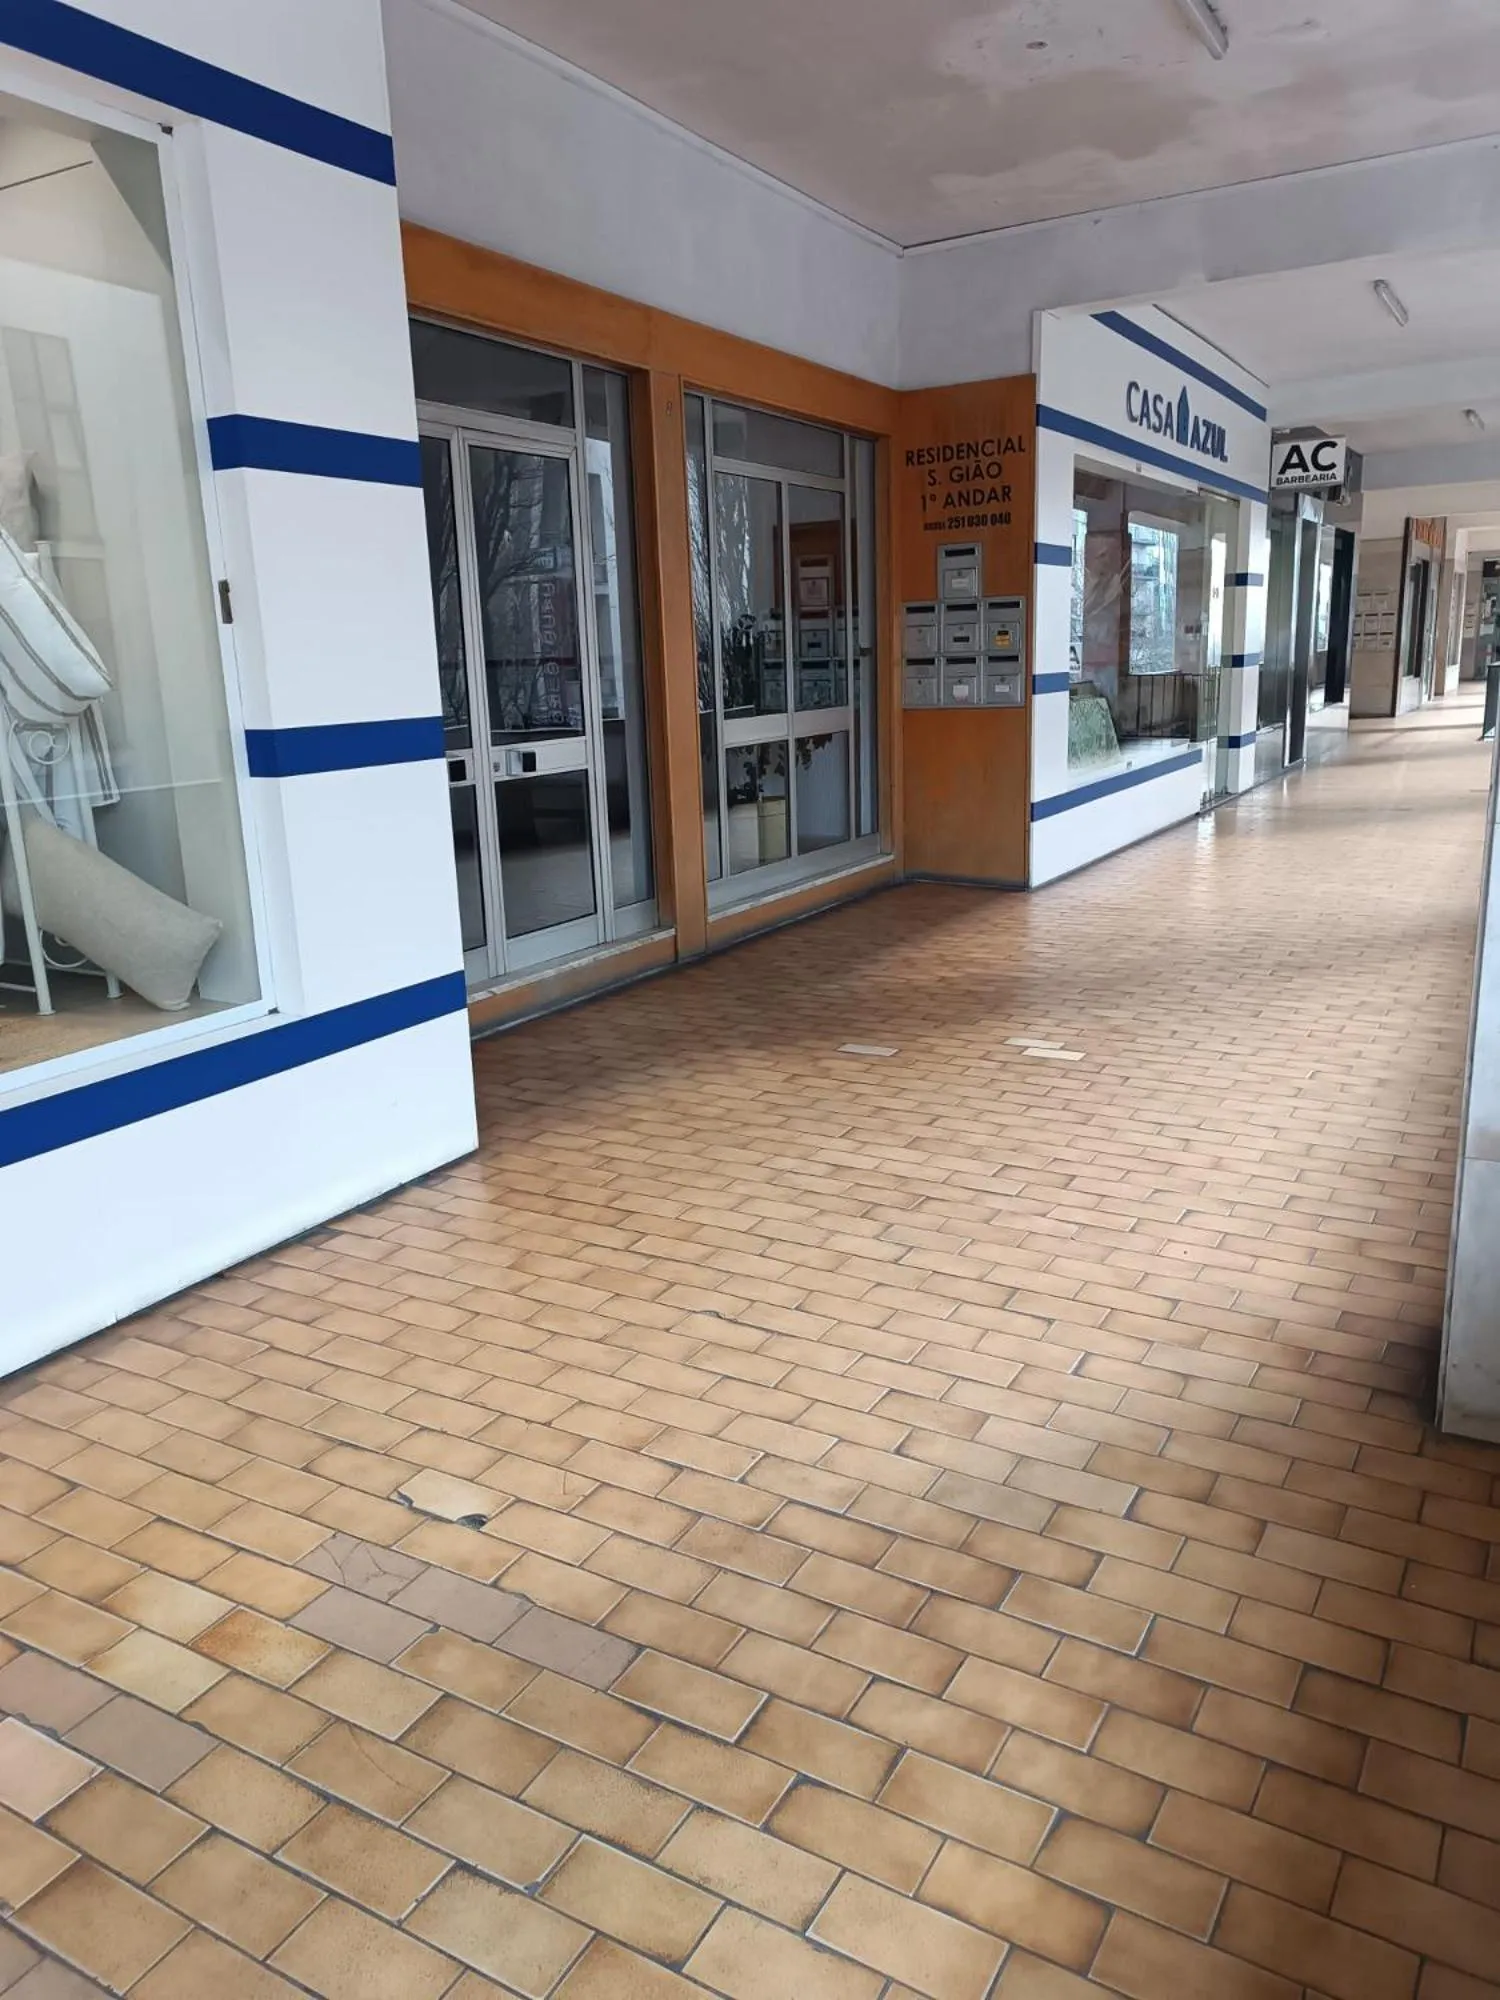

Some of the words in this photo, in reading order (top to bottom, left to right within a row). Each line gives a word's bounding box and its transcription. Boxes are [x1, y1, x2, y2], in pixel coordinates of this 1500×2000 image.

[1126, 381, 1174, 441] CASA
[1189, 415, 1228, 463] AZUL
[905, 435, 1025, 467] RESIDENCIAL
[1278, 440, 1338, 475] AC
[927, 468, 942, 487] S.
[948, 459, 1002, 484] GIÃO
[1276, 472, 1337, 485] BARBEARIA
[942, 484, 1012, 509] ANDAR
